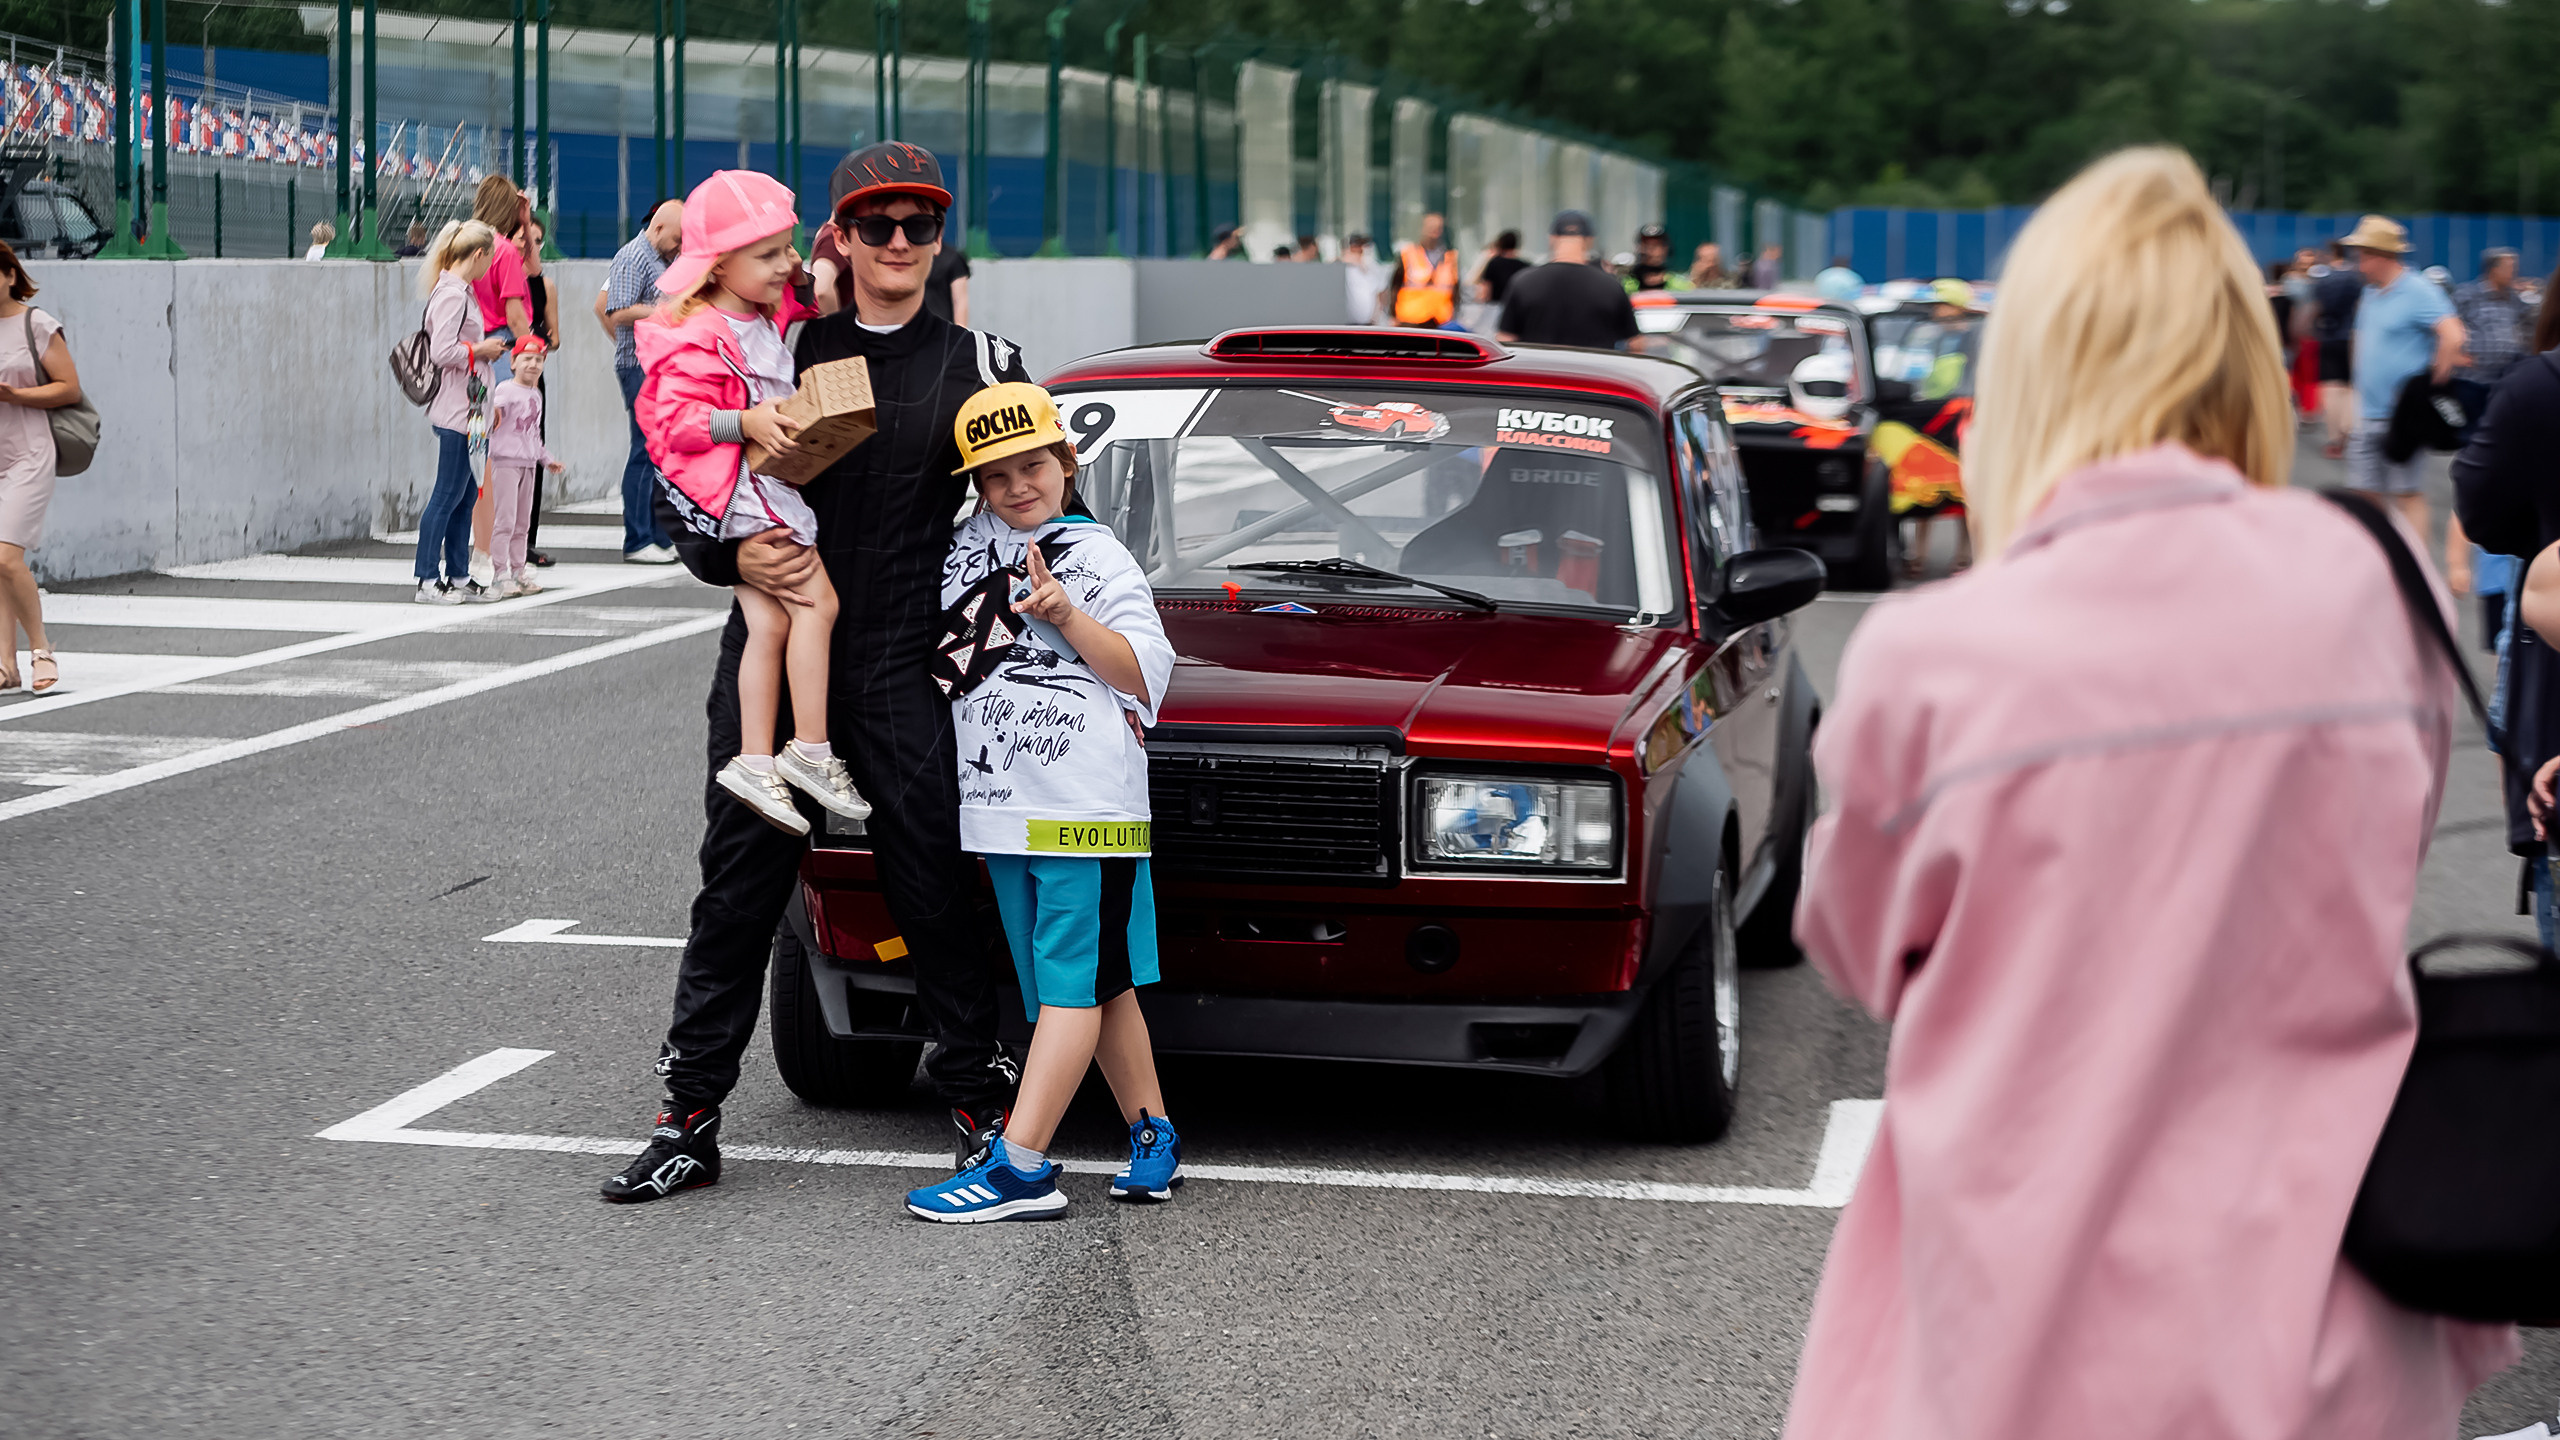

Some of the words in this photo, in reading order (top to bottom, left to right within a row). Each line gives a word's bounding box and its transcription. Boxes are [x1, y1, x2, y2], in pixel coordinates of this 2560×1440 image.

[966, 404, 1034, 444] GOCHA
[1056, 402, 1116, 454] 9
[1496, 430, 1611, 454] КЛАССИКИ
[1497, 408, 1614, 439] КУБОК
[1510, 468, 1601, 487] BRIDE
[972, 688, 1015, 726] the
[1021, 692, 1085, 732] urban
[1003, 731, 1070, 771] jungle
